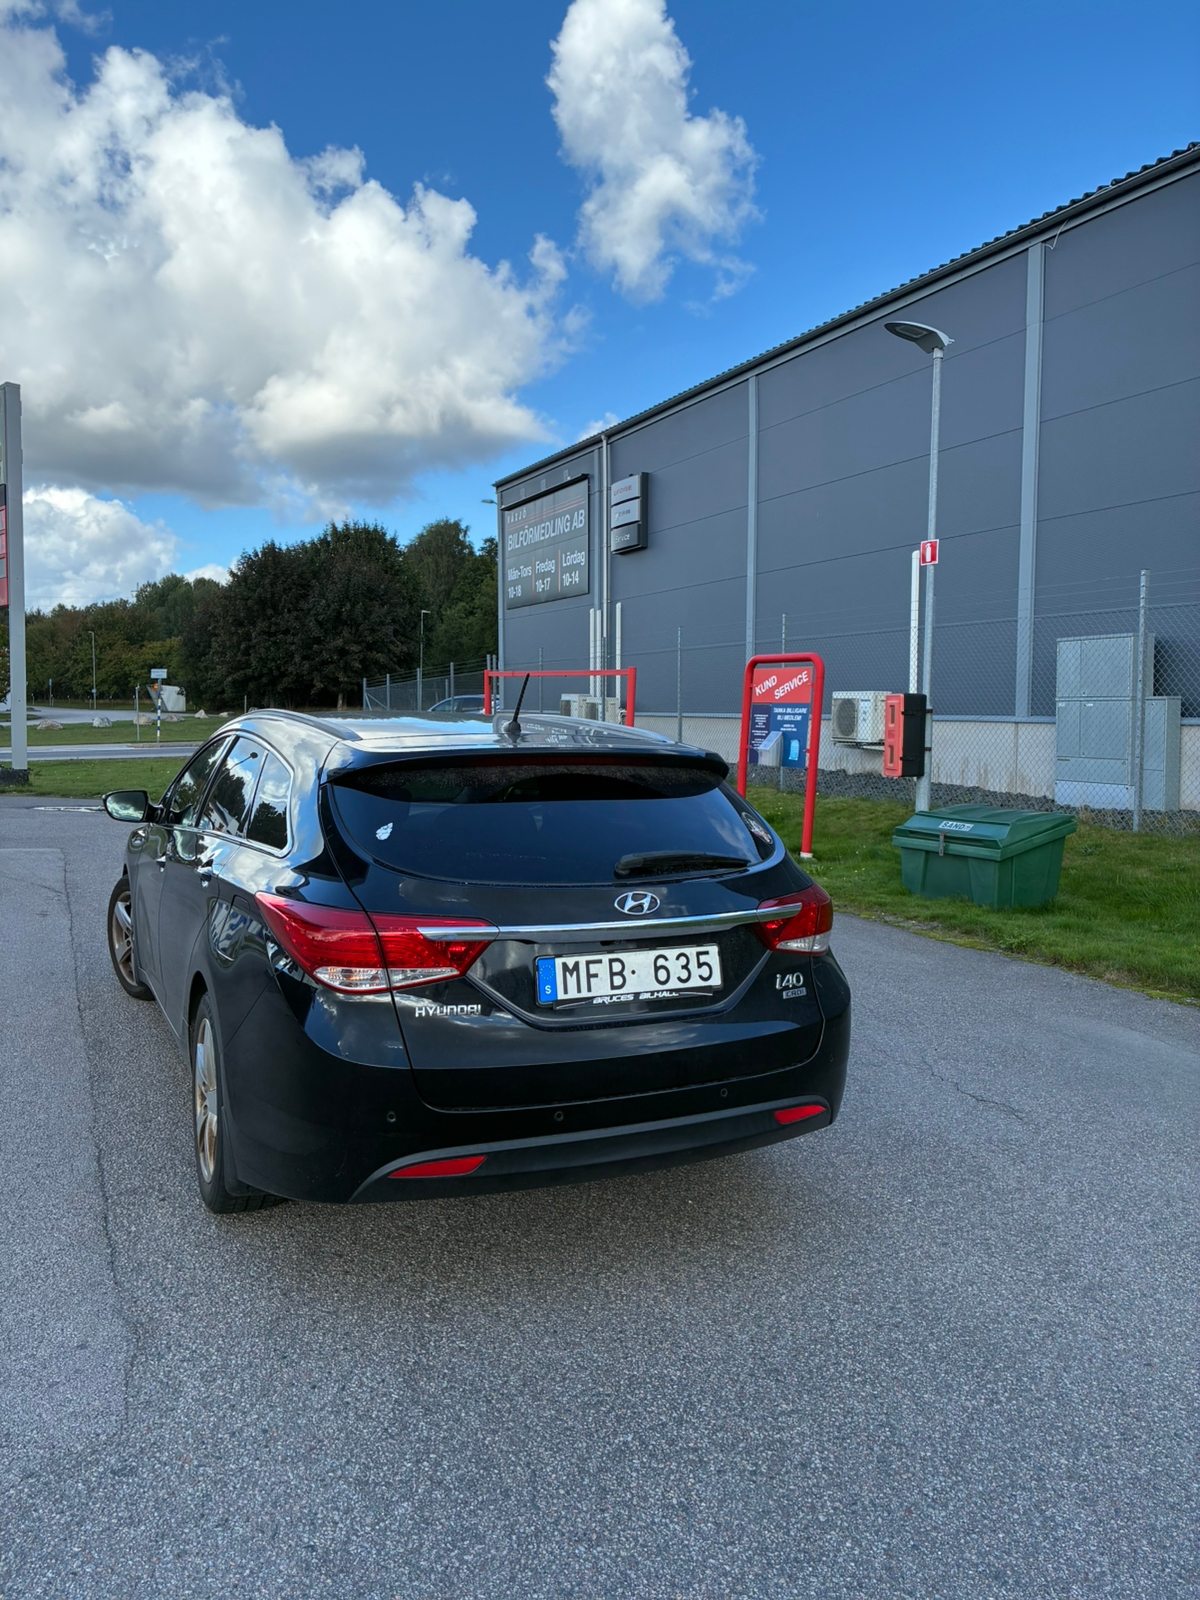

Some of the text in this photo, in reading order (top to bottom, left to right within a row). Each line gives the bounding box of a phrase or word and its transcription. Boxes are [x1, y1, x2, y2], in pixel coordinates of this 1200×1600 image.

[507, 514, 571, 551] BILFÖRMEDLING
[571, 509, 585, 531] AB
[535, 559, 556, 574] Fredag
[562, 550, 586, 567] Lördag
[507, 565, 532, 581] Mån-Tors
[562, 570, 579, 587] 10-14
[535, 578, 551, 592] 10-17
[755, 675, 778, 696] KUND
[774, 671, 809, 699] SERVICE
[941, 821, 966, 830] SAND
[561, 950, 713, 995] MFB 635
[775, 972, 804, 989] i40
[544, 985, 552, 994] S
[593, 993, 635, 1004] BRUCES
[415, 1004, 481, 1017] HYUNDAI
